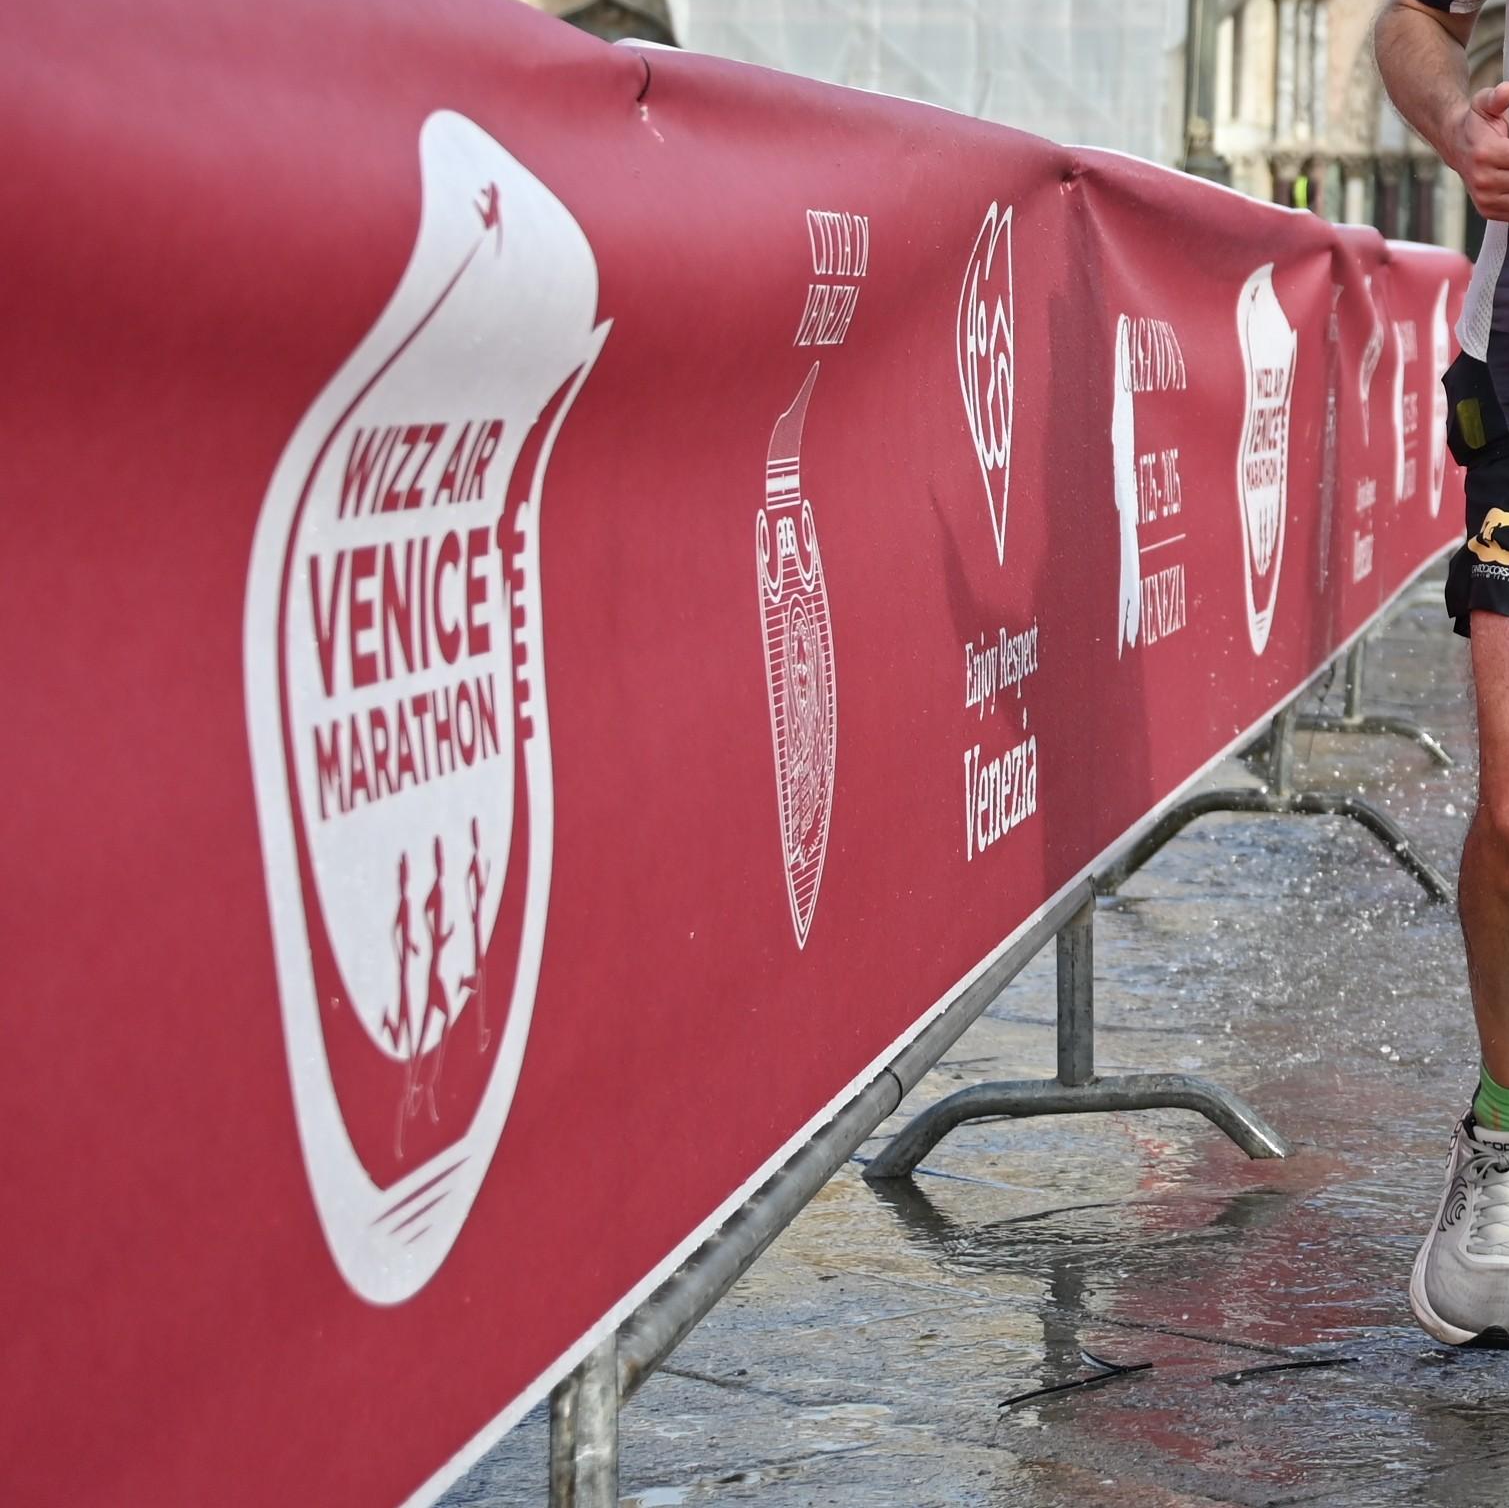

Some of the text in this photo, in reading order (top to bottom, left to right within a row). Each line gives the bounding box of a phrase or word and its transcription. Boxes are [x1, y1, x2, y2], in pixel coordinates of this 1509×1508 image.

[793, 284, 860, 348] VENEZIA
[1121, 316, 1187, 393] CASANOVA
[337, 418, 505, 520] WIZZ AIR
[309, 524, 492, 699] VENICE
[1139, 563, 1187, 648] VENEZIA
[965, 615, 1038, 721] Enjoy Respect
[313, 672, 501, 822] MARATHON
[964, 706, 1038, 862] Venezia
